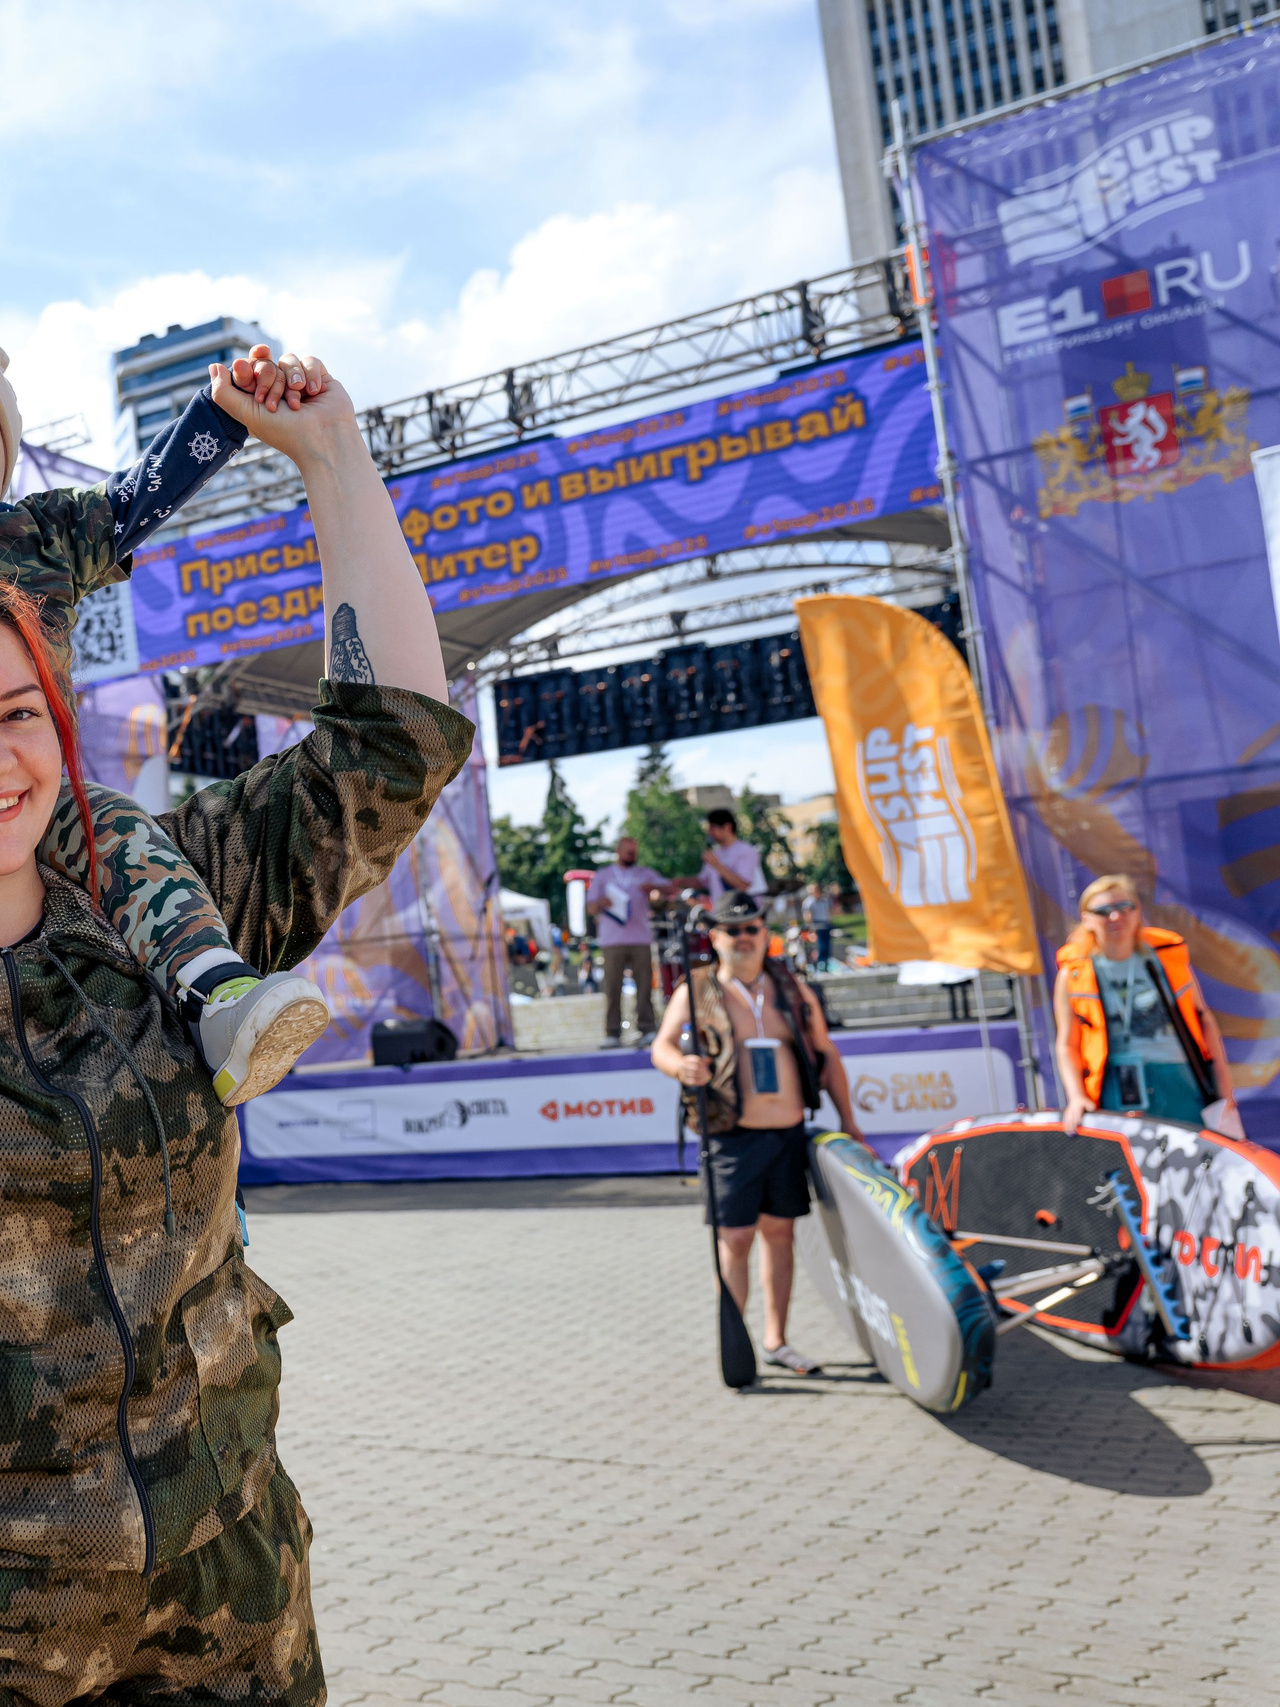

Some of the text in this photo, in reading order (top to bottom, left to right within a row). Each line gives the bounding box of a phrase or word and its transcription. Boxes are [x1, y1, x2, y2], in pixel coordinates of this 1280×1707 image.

[1096, 114, 1215, 178] SUP
[1104, 150, 1222, 223] FEST
[997, 240, 1252, 348] E1 RU
[180, 537, 320, 596] Присы
[401, 489, 515, 548] фото
[522, 479, 551, 510] и
[558, 391, 867, 502] выигрывай
[186, 584, 324, 639] поездк
[865, 726, 914, 821] SUP
[901, 723, 949, 816] FEST
[563, 1097, 656, 1119] МОТИВ
[891, 1071, 954, 1094] SIMA
[893, 1091, 958, 1113] LAND
